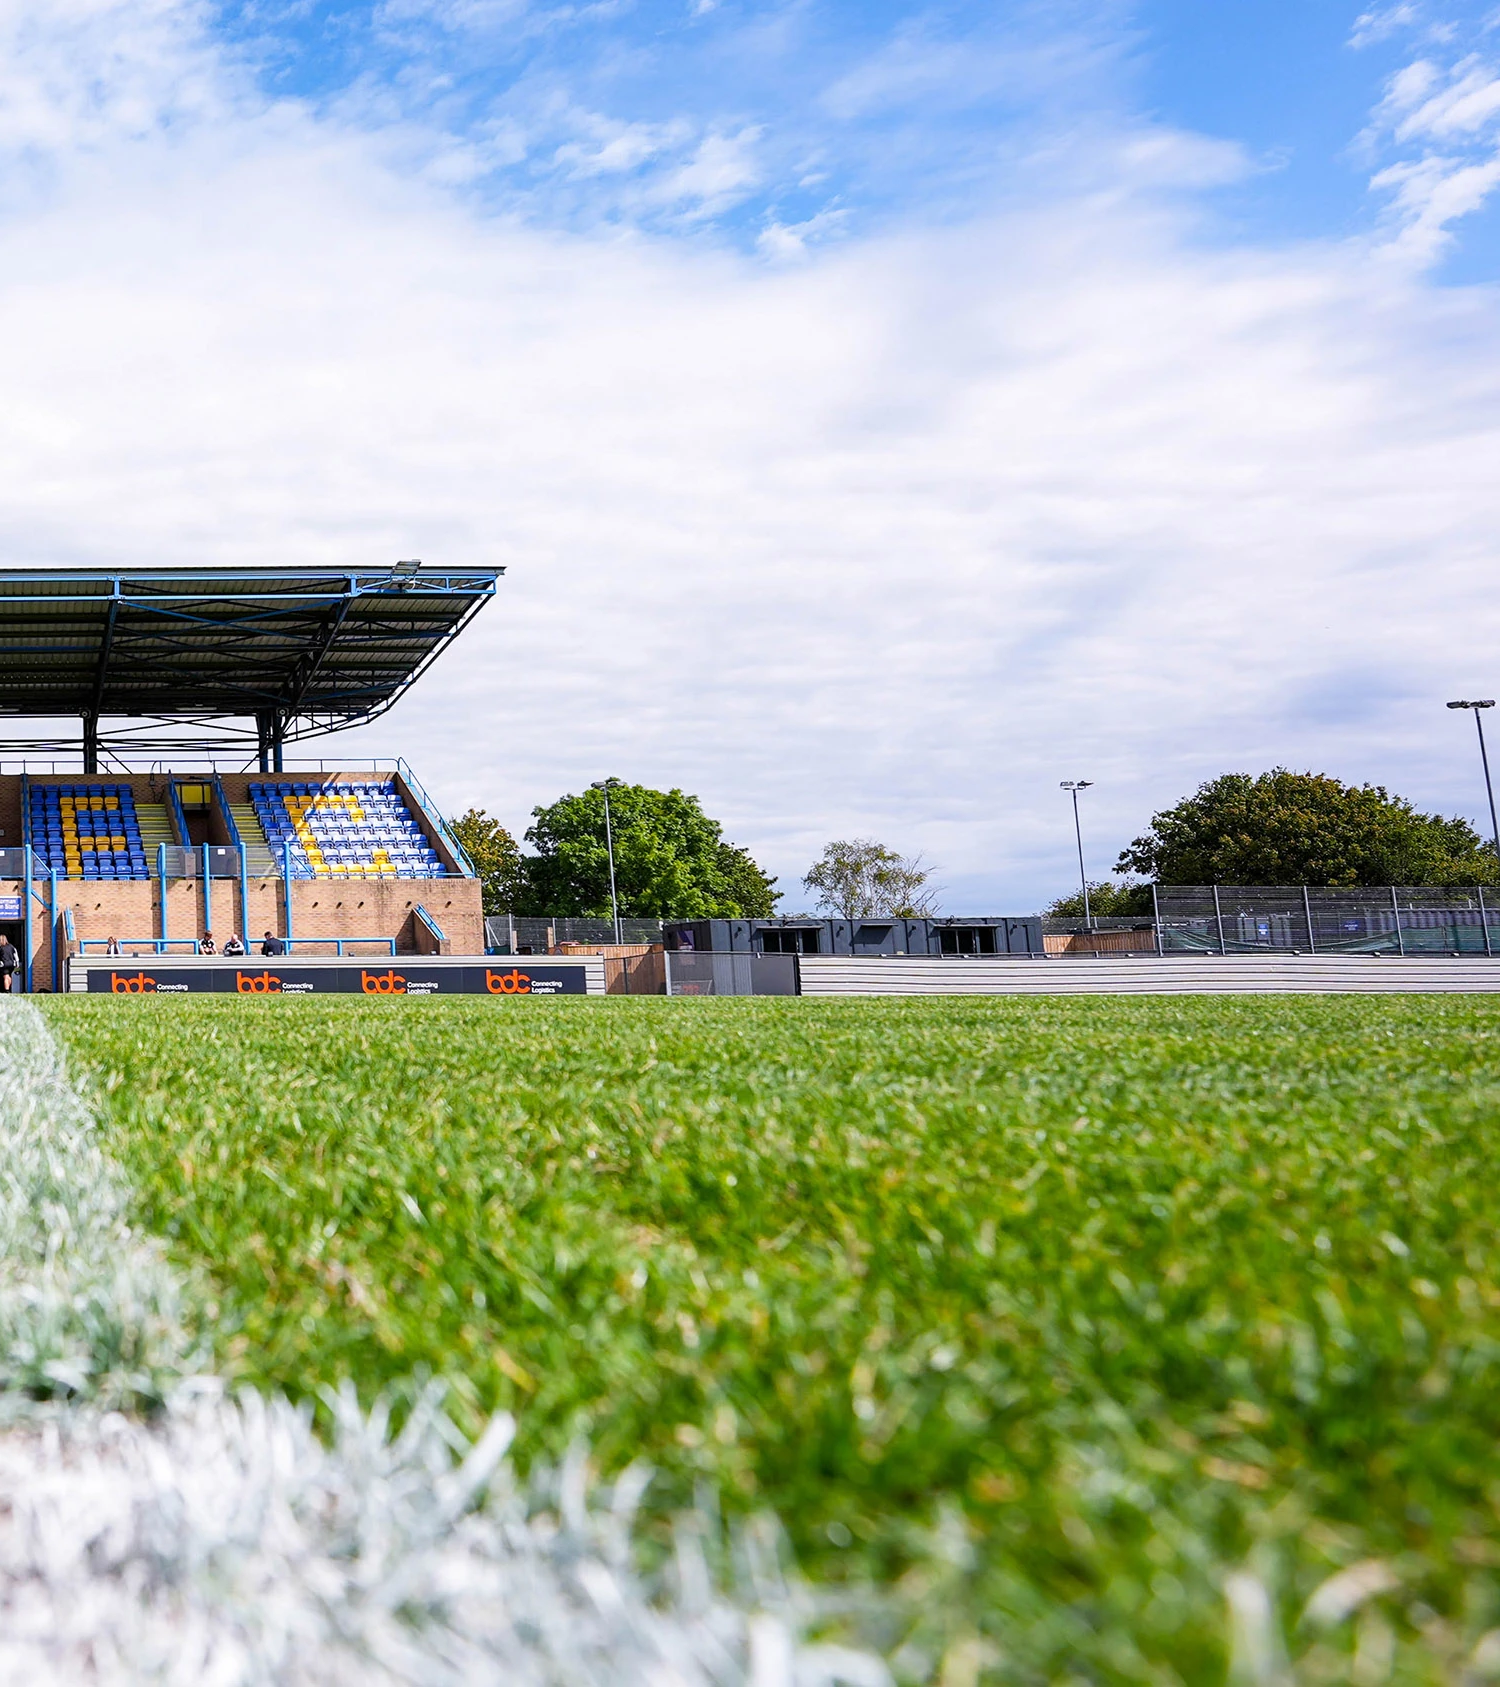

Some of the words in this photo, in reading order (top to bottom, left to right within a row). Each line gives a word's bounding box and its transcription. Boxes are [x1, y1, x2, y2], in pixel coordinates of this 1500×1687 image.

[60, 796, 126, 880] F
[283, 795, 396, 880] C
[112, 972, 156, 993] bdc
[237, 971, 281, 993] bdc
[282, 982, 313, 990] Connecting
[362, 970, 406, 994] bdc
[486, 969, 531, 994] bdc
